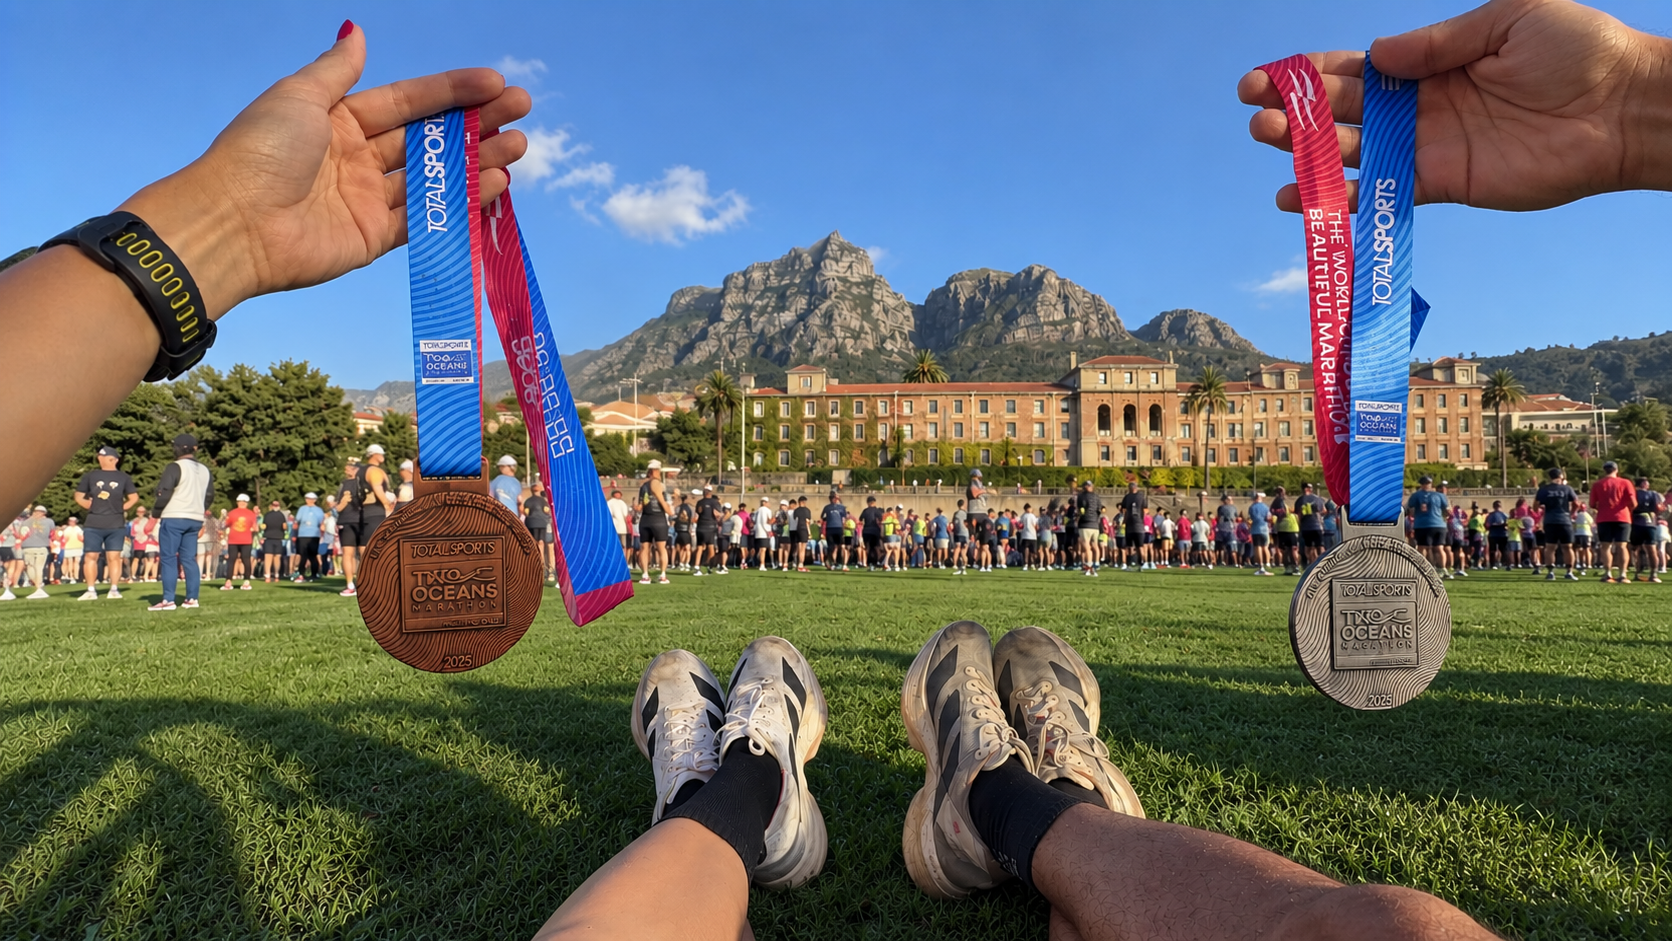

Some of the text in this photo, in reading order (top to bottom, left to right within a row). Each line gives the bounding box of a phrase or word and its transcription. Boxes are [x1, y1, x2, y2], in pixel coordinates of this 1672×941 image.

[1328, 209, 1345, 245] THE
[1372, 178, 1397, 306] TOTALSPORTS
[411, 541, 496, 558] TOTALSPORTS
[411, 583, 498, 602] OCEANS
[1341, 583, 1413, 596] TOTALSPORTS
[1341, 624, 1414, 641] OCEANS
[444, 655, 472, 668] 2025
[1368, 694, 1392, 706] 2025
